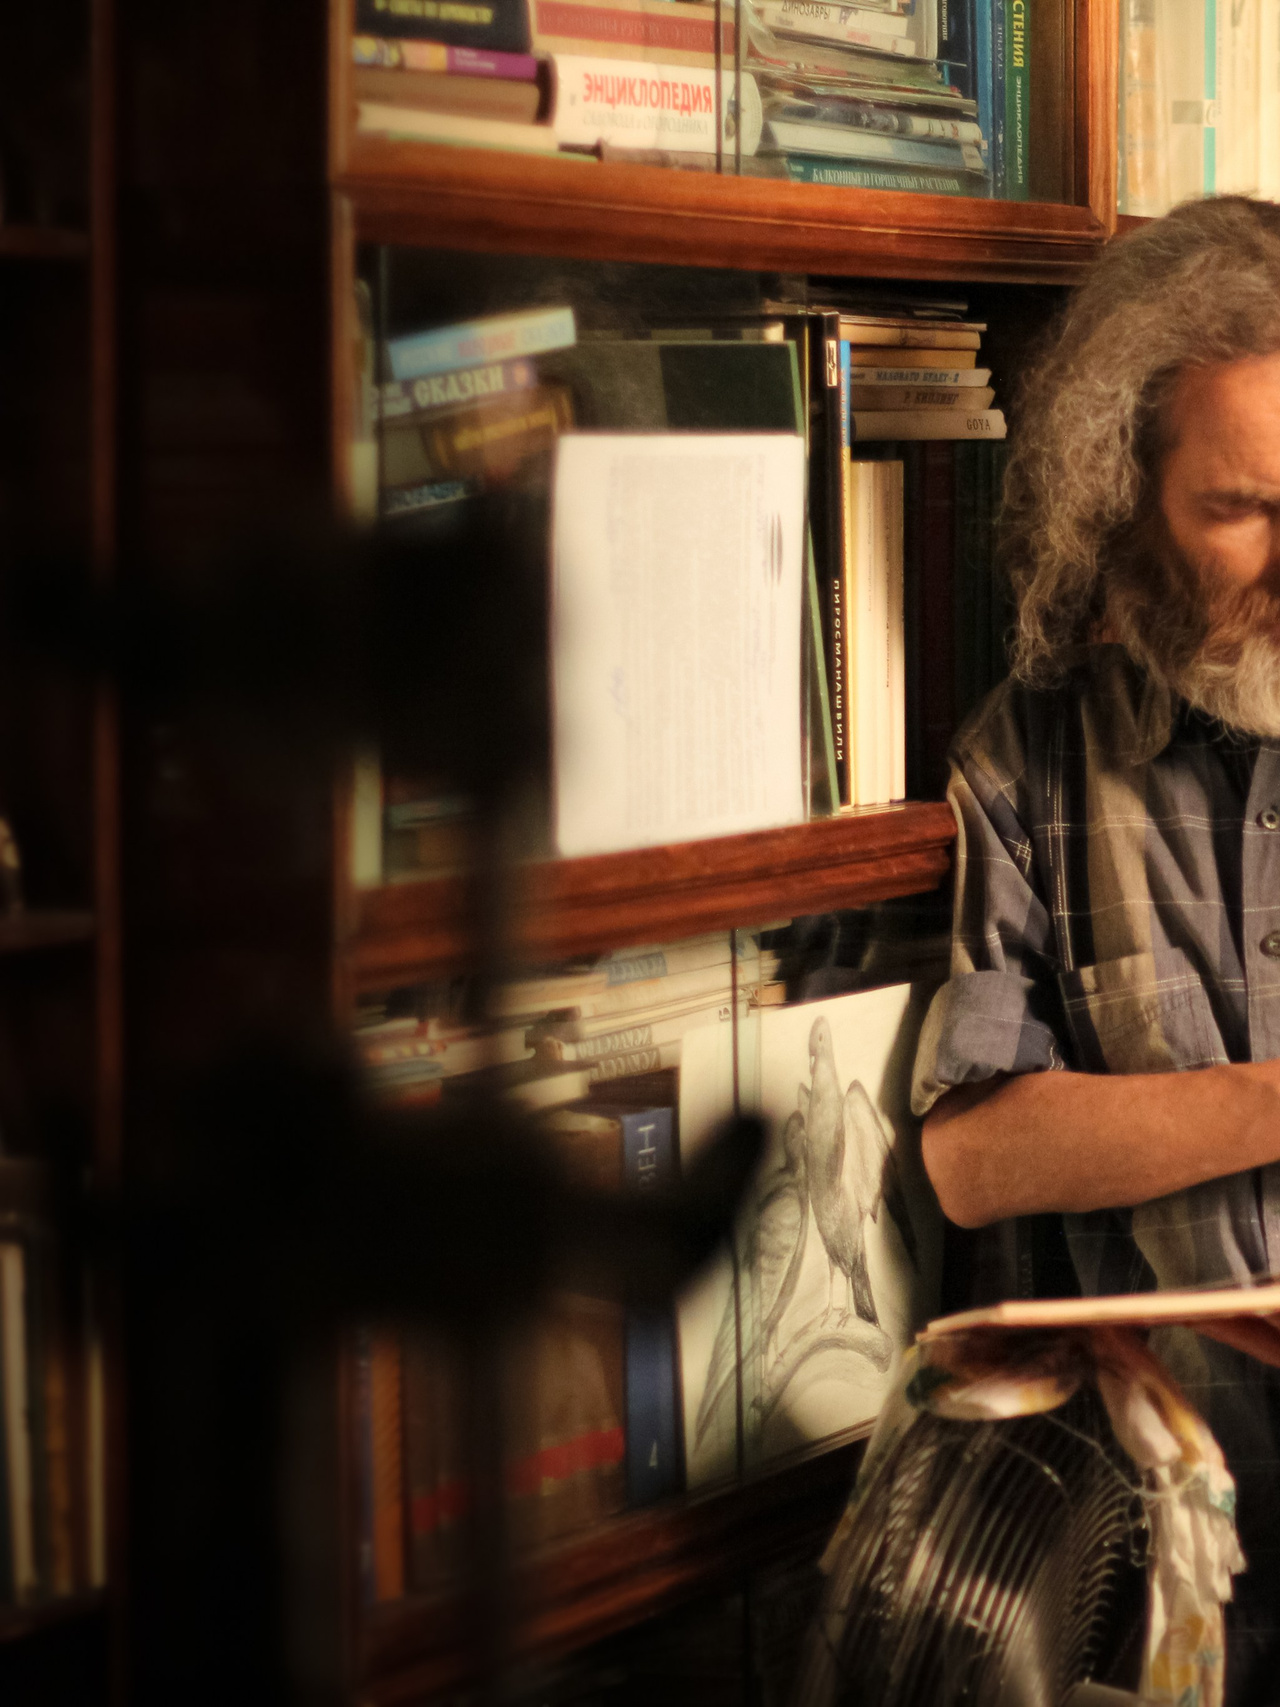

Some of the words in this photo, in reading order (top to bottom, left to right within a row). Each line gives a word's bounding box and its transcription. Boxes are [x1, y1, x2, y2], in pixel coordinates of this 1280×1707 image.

[781, 1, 830, 20] ДИНОЗАВРЫ
[583, 72, 713, 117] ЭНЦИКЛОПЕДИЯ
[1015, 76, 1023, 184] ЭНЦИКЛОПЕДИЯ
[812, 168, 862, 185] БАЛКОННЫЕ
[870, 173, 919, 189] ГОРШЕЧНЫЕ
[920, 177, 960, 191] РАСТЕНИЯ
[413, 365, 505, 408] СКАЗКИ
[966, 418, 991, 431] GOYA
[833, 579, 843, 761] ПИРОСМАНАШВИЛИ
